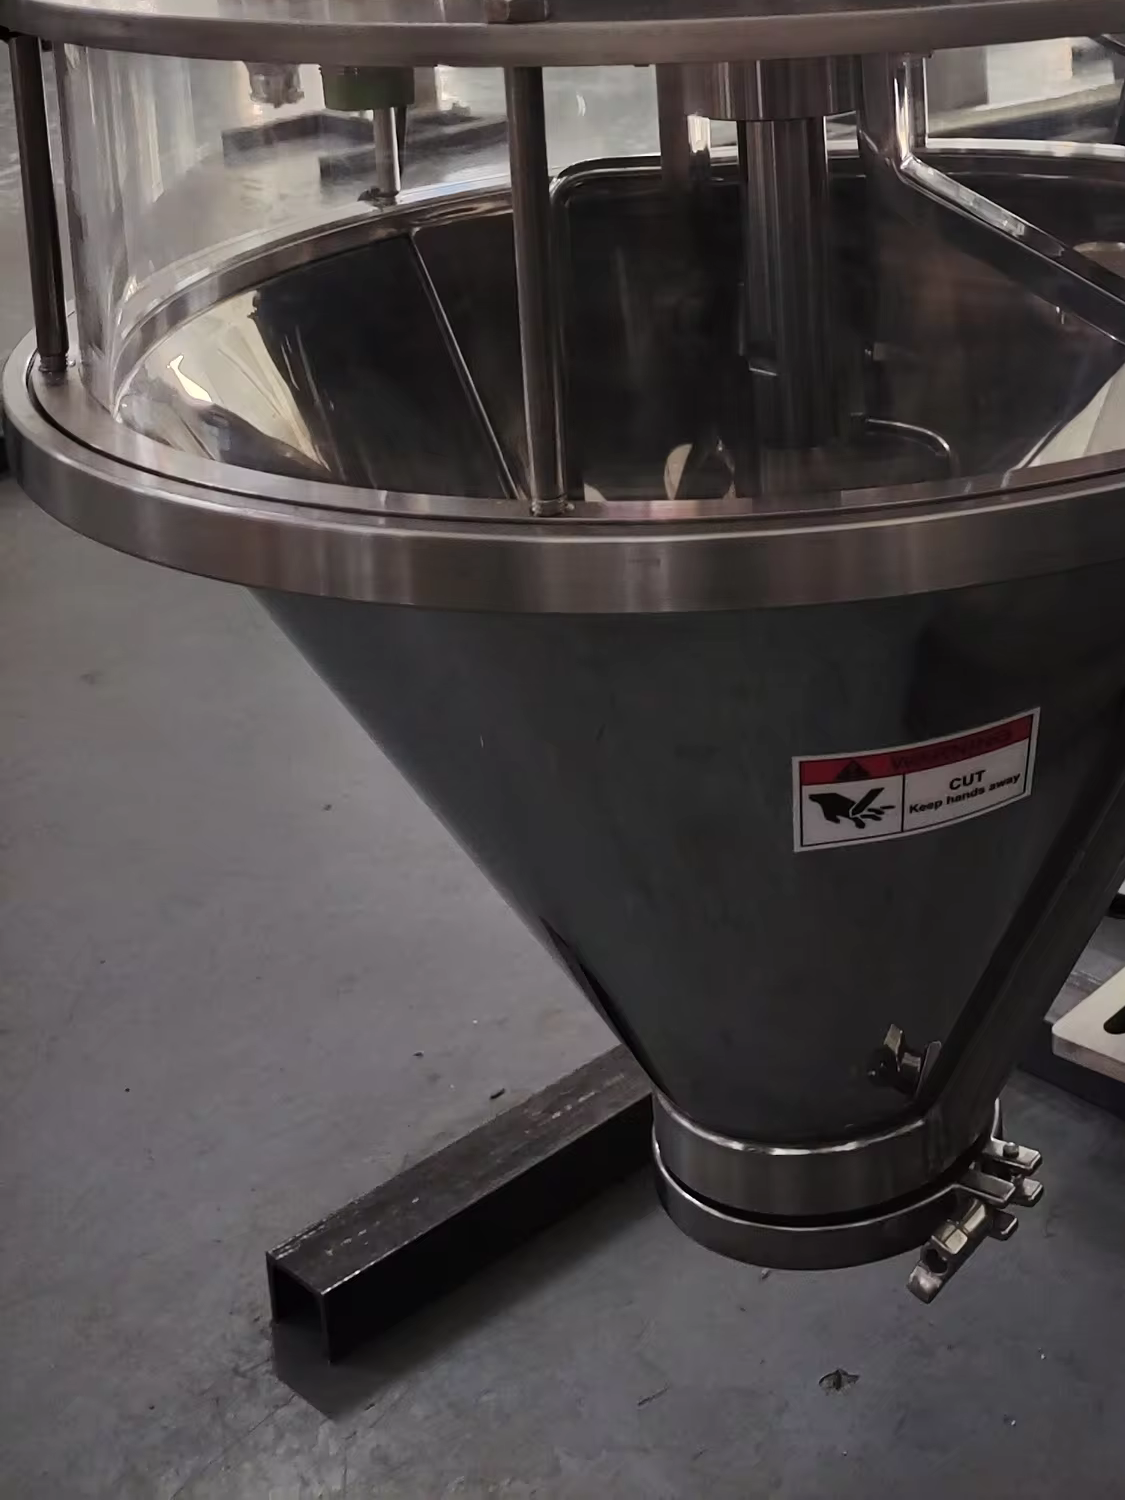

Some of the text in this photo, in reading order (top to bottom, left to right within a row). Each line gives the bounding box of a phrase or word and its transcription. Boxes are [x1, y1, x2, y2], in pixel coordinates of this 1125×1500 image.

[909, 773, 1021, 814] Keep hands away
[948, 770, 986, 790] CUT
